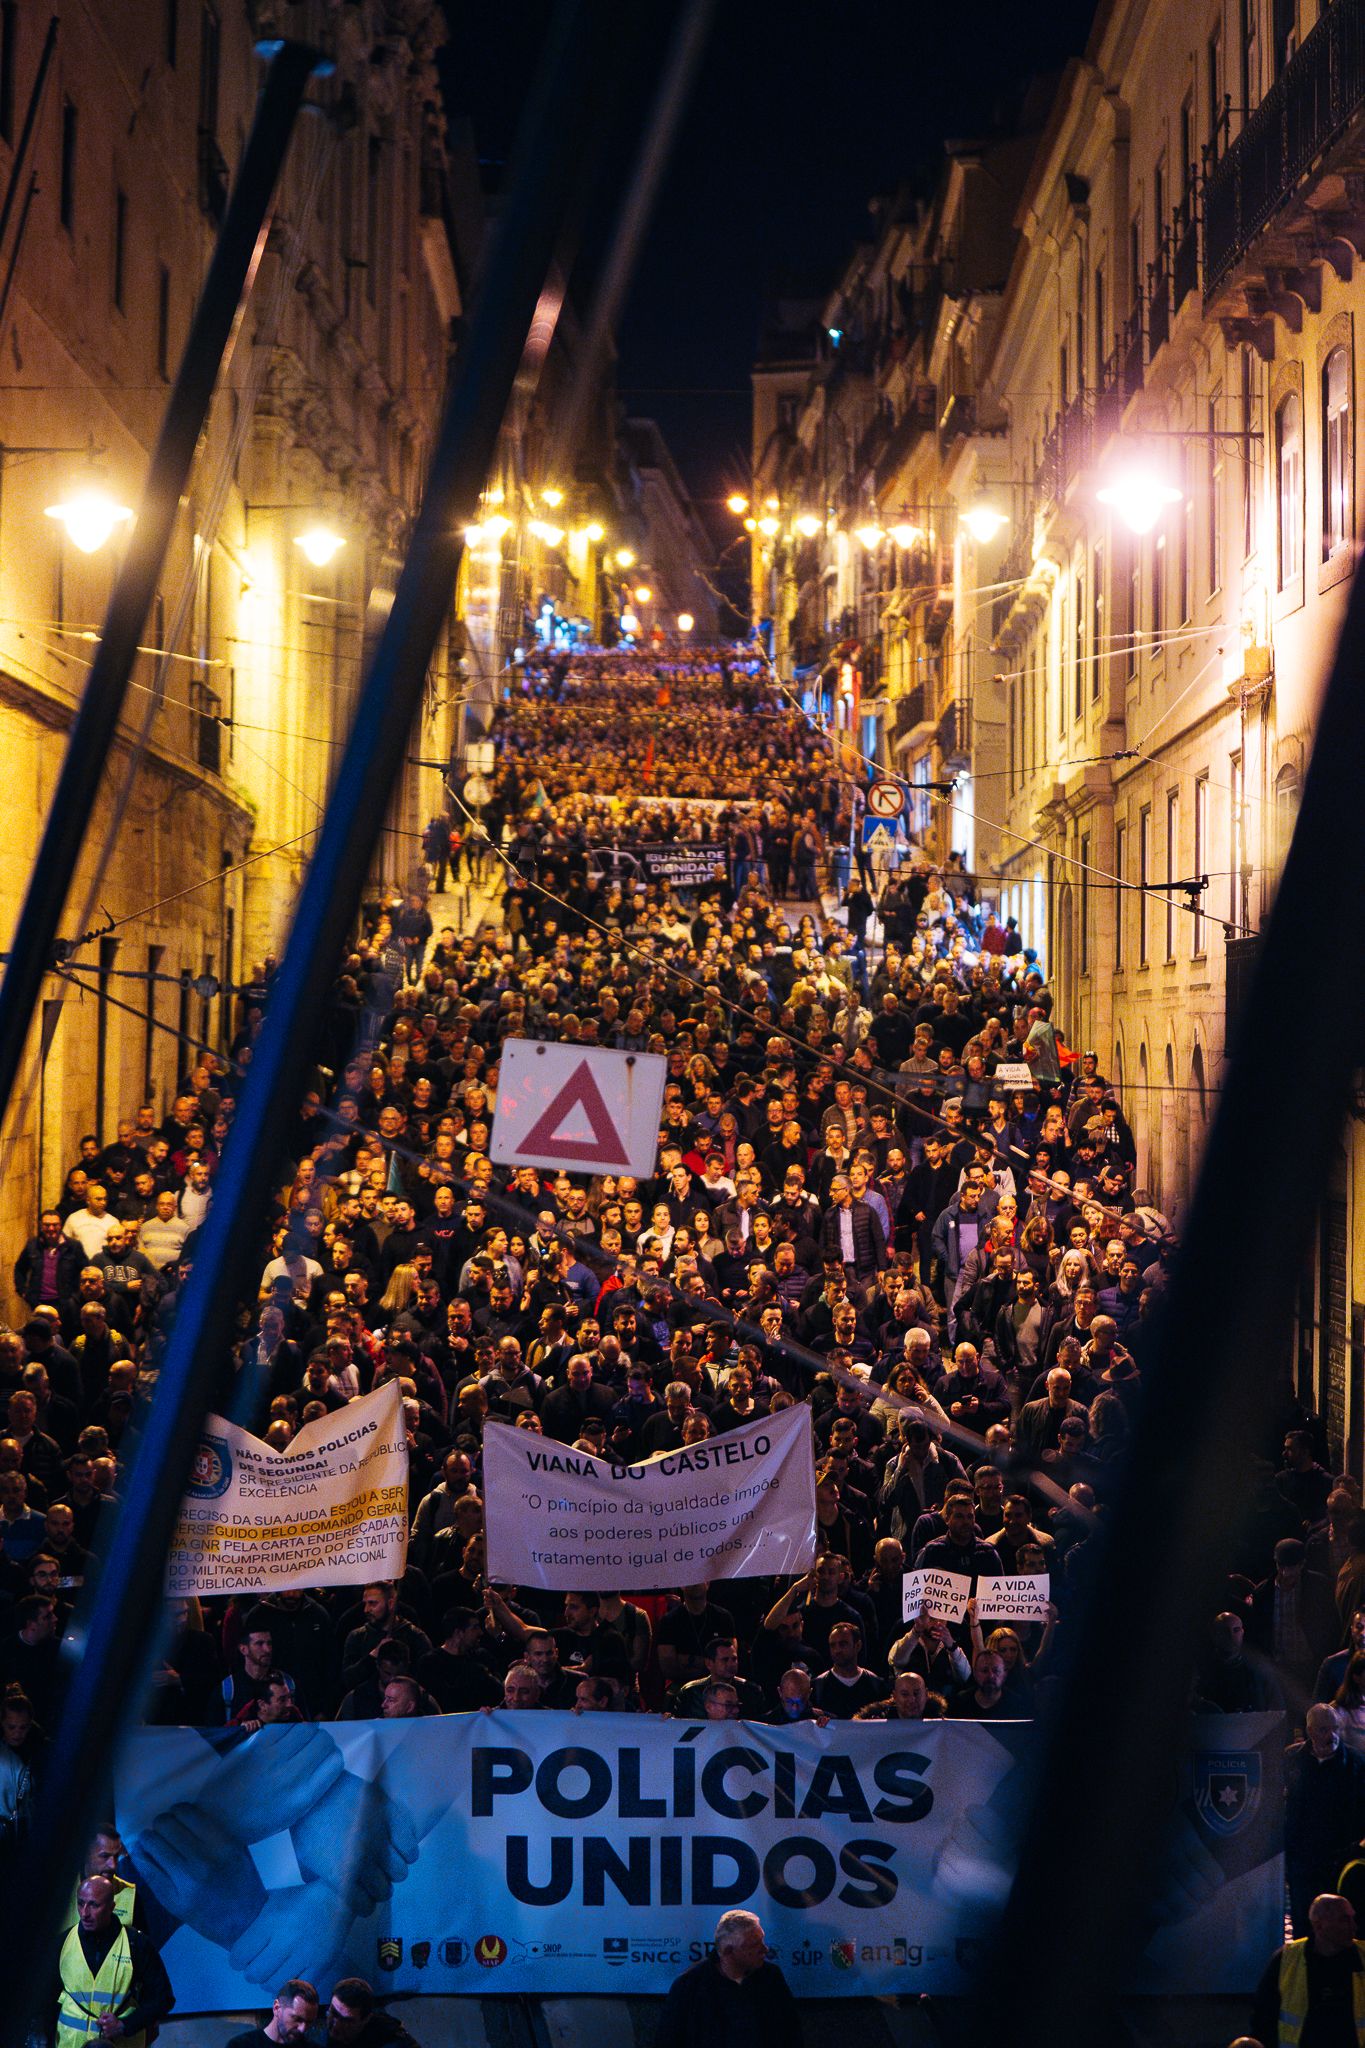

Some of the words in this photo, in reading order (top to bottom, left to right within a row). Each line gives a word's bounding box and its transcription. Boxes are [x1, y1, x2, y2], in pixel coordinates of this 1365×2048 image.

[236, 1448, 262, 1461] NÃO
[266, 1450, 316, 1465] SOMOS
[318, 1421, 378, 1455] POLICIAS
[239, 1462, 255, 1473] DE
[258, 1459, 328, 1477] SEGUNDA!
[526, 1451, 599, 1479] VIANA
[610, 1463, 646, 1480] DO
[659, 1435, 772, 1476] CASTELO
[240, 1474, 257, 1485] SR
[260, 1468, 337, 1488] PRESIDENTE
[340, 1462, 357, 1475] DA
[240, 1483, 318, 1498] EXCELÊNCIA
[548, 1497, 618, 1516] princípio
[623, 1499, 643, 1514] da
[649, 1492, 730, 1516] igualdade
[734, 1478, 780, 1502] impõe
[178, 1508, 229, 1524] RECISO
[232, 1514, 252, 1526] DA
[254, 1515, 282, 1526] SUA
[283, 1508, 327, 1523] AJUDA
[330, 1493, 367, 1516] ESTOU
[369, 1491, 379, 1502] A
[381, 1486, 405, 1500] SER
[262, 1525, 298, 1538] PELO
[301, 1510, 364, 1534] COMANDO
[367, 1502, 406, 1517] GERAL
[549, 1527, 579, 1539] aos
[584, 1526, 652, 1542] poderes
[658, 1520, 727, 1542] públicos
[732, 1510, 754, 1526] um
[190, 1539, 220, 1551] GNR
[224, 1540, 258, 1552] PELA
[261, 1537, 305, 1551] CARTA
[308, 1519, 389, 1545] ENDEREÇADA
[390, 1516, 399, 1528] A
[169, 1550, 204, 1562] PELO
[208, 1547, 321, 1564] INCUMPRIMENTO
[324, 1542, 344, 1554] DO
[347, 1531, 405, 1550] ESTATUTO
[531, 1550, 623, 1566] tratamento
[628, 1549, 667, 1568] igual
[673, 1550, 694, 1562] de
[169, 1565, 188, 1576] DO
[192, 1565, 243, 1576] MILITAR
[247, 1565, 267, 1575] DA
[269, 1558, 326, 1574] GUARDA
[328, 1549, 387, 1566] NACIONAL
[168, 1576, 266, 1591] REPUBLICANA.
[912, 1575, 920, 1587] A
[923, 1574, 953, 1588] VIDA
[991, 1581, 1001, 1591] A
[1005, 1580, 1036, 1591] VIDA
[924, 1586, 948, 1600] GNR
[950, 1592, 967, 1603] GP
[996, 1592, 1045, 1603] POLÍCIAS
[907, 1598, 959, 1616] IMPORTA
[982, 1603, 1043, 1615] IMPORTA
[471, 1726, 934, 1824] POLÍCIAS
[506, 1835, 900, 1910] UNIDOS
[631, 1951, 682, 1964] SNCC
[791, 1951, 823, 1966] SUP
